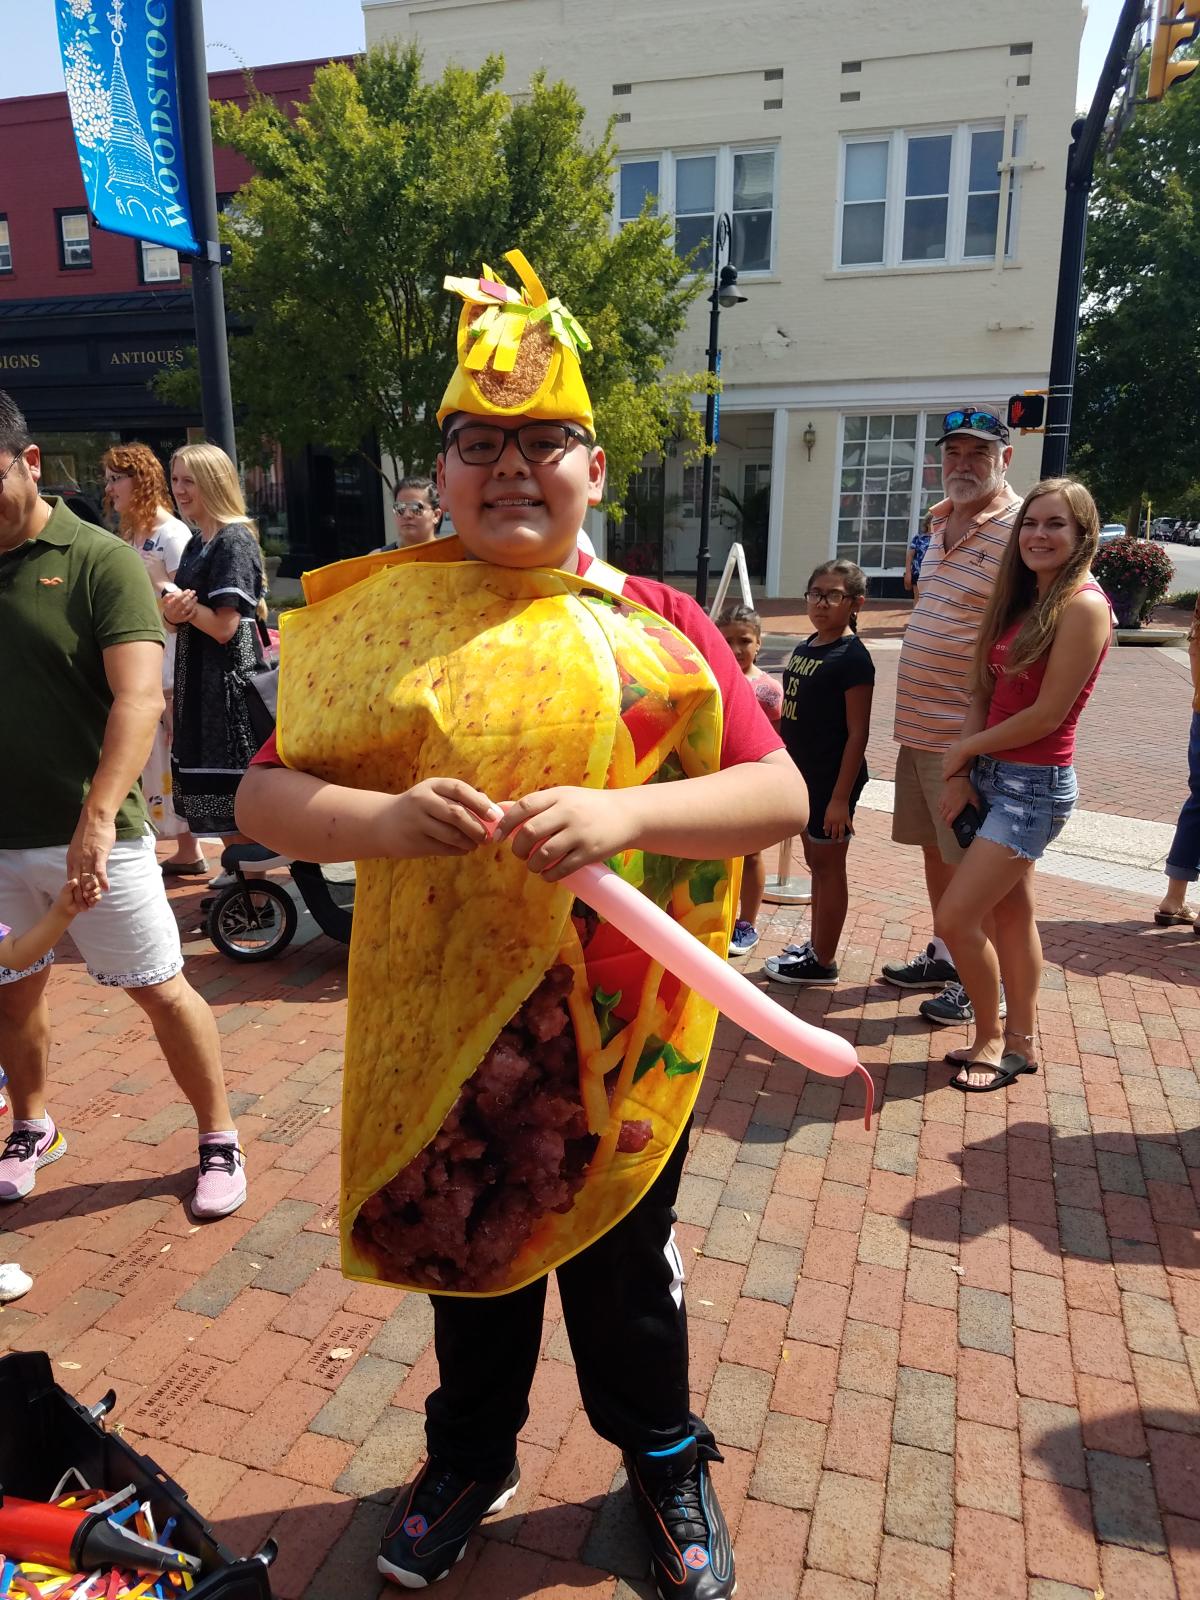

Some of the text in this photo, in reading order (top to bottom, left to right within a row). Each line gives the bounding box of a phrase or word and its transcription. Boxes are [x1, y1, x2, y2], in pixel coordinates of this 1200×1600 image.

[0, 354, 41, 369] IGNS
[110, 350, 184, 365] ANTIQUES
[785, 676, 800, 696] IS
[307, 1326, 344, 1365] THANK YOU
[339, 1325, 359, 1342] NEAL
[134, 1361, 190, 1417] IN MEMORY OF
[149, 1367, 202, 1419] DEE SHAFFER
[176, 1365, 218, 1407] VOLUNTEER
